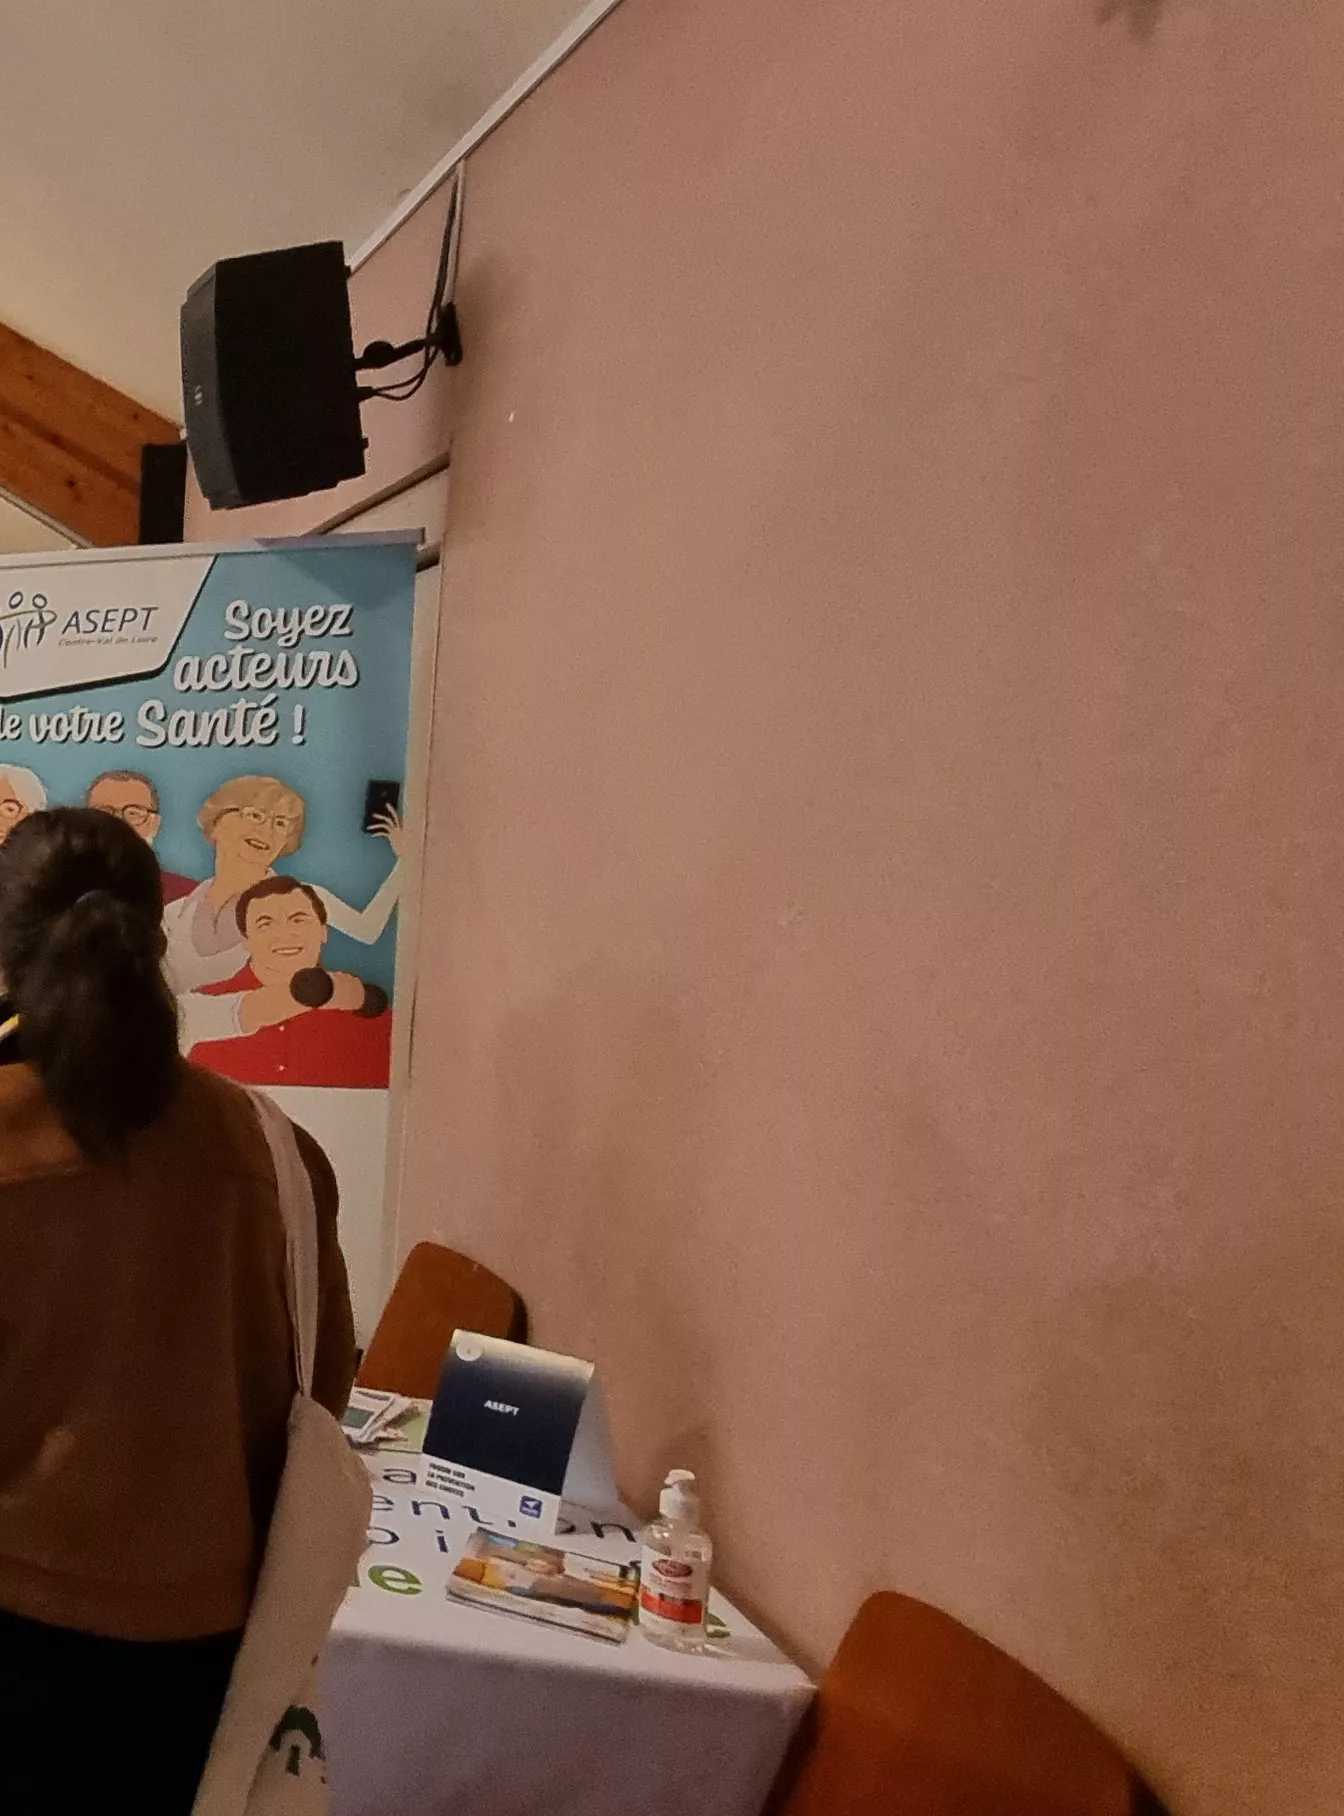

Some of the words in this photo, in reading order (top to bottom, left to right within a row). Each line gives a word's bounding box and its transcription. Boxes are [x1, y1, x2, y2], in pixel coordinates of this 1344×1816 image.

[62, 606, 160, 635] ASEPT
[224, 600, 354, 648] Soyez
[173, 647, 359, 692] acteurs
[29, 705, 125, 743] votre
[136, 693, 279, 748] Santé
[291, 704, 307, 745] !
[484, 1400, 520, 1416] ASEPT
